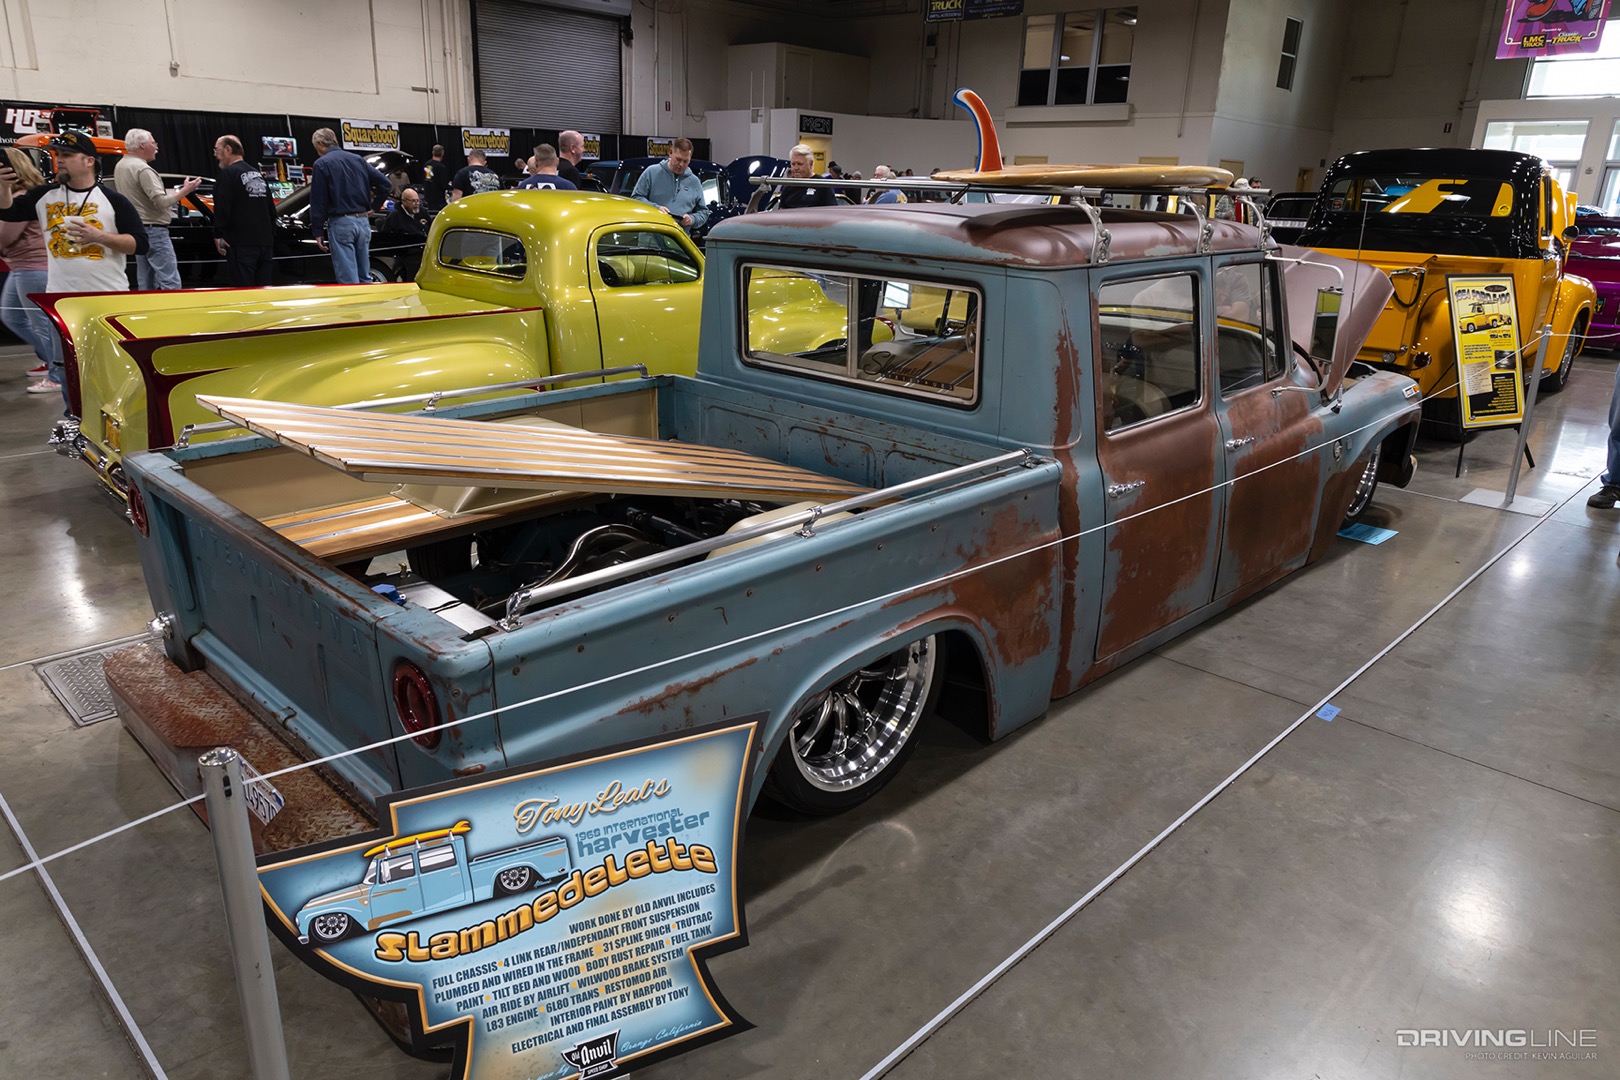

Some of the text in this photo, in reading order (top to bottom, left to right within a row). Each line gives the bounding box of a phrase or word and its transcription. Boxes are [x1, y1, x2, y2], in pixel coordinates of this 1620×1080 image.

[931, 0, 962, 10] TRUCK
[1552, 35, 1583, 44] TRUCK
[343, 122, 398, 149] Squarebody
[463, 130, 509, 154] Squarebody
[802, 117, 831, 133] MEN
[513, 796, 588, 835] Tony
[577, 811, 711, 858] harvester
[569, 883, 716, 935] WORK DONE BY OLD ANVIL INCLUDES
[432, 974, 454, 990] FULL
[456, 961, 499, 983] CHASSIS
[503, 957, 510, 968] 4
[511, 951, 533, 966] LINK
[621, 917, 648, 933] FRONT
[649, 901, 700, 925] SUSPENSION
[434, 911, 713, 1003] PLUMBED AND WIRED IN THE FRAME 31 SPLINE 9INCH TRUTRAC
[456, 924, 712, 1012] PAINT TILT BED AND WOOD BODY RUST REPAIR FUEL TANK
[482, 947, 684, 1019] AIR RIDE BY AIRLIFT WILWOOD BRAKE SYSTEM
[486, 966, 667, 1032] L83 ENGINE 6L80 TRANS RESTOMOD AIR
[511, 986, 689, 1054] ELECTRICAL AND FINAL ASSEMBLY BY TONY
[550, 979, 673, 1027] INTERIOR PAINT BY HARPOON
[571, 1038, 612, 1066] Old Anvil
[621, 1020, 703, 1052] Orange California
[587, 1063, 608, 1075] SPEED SHOP
